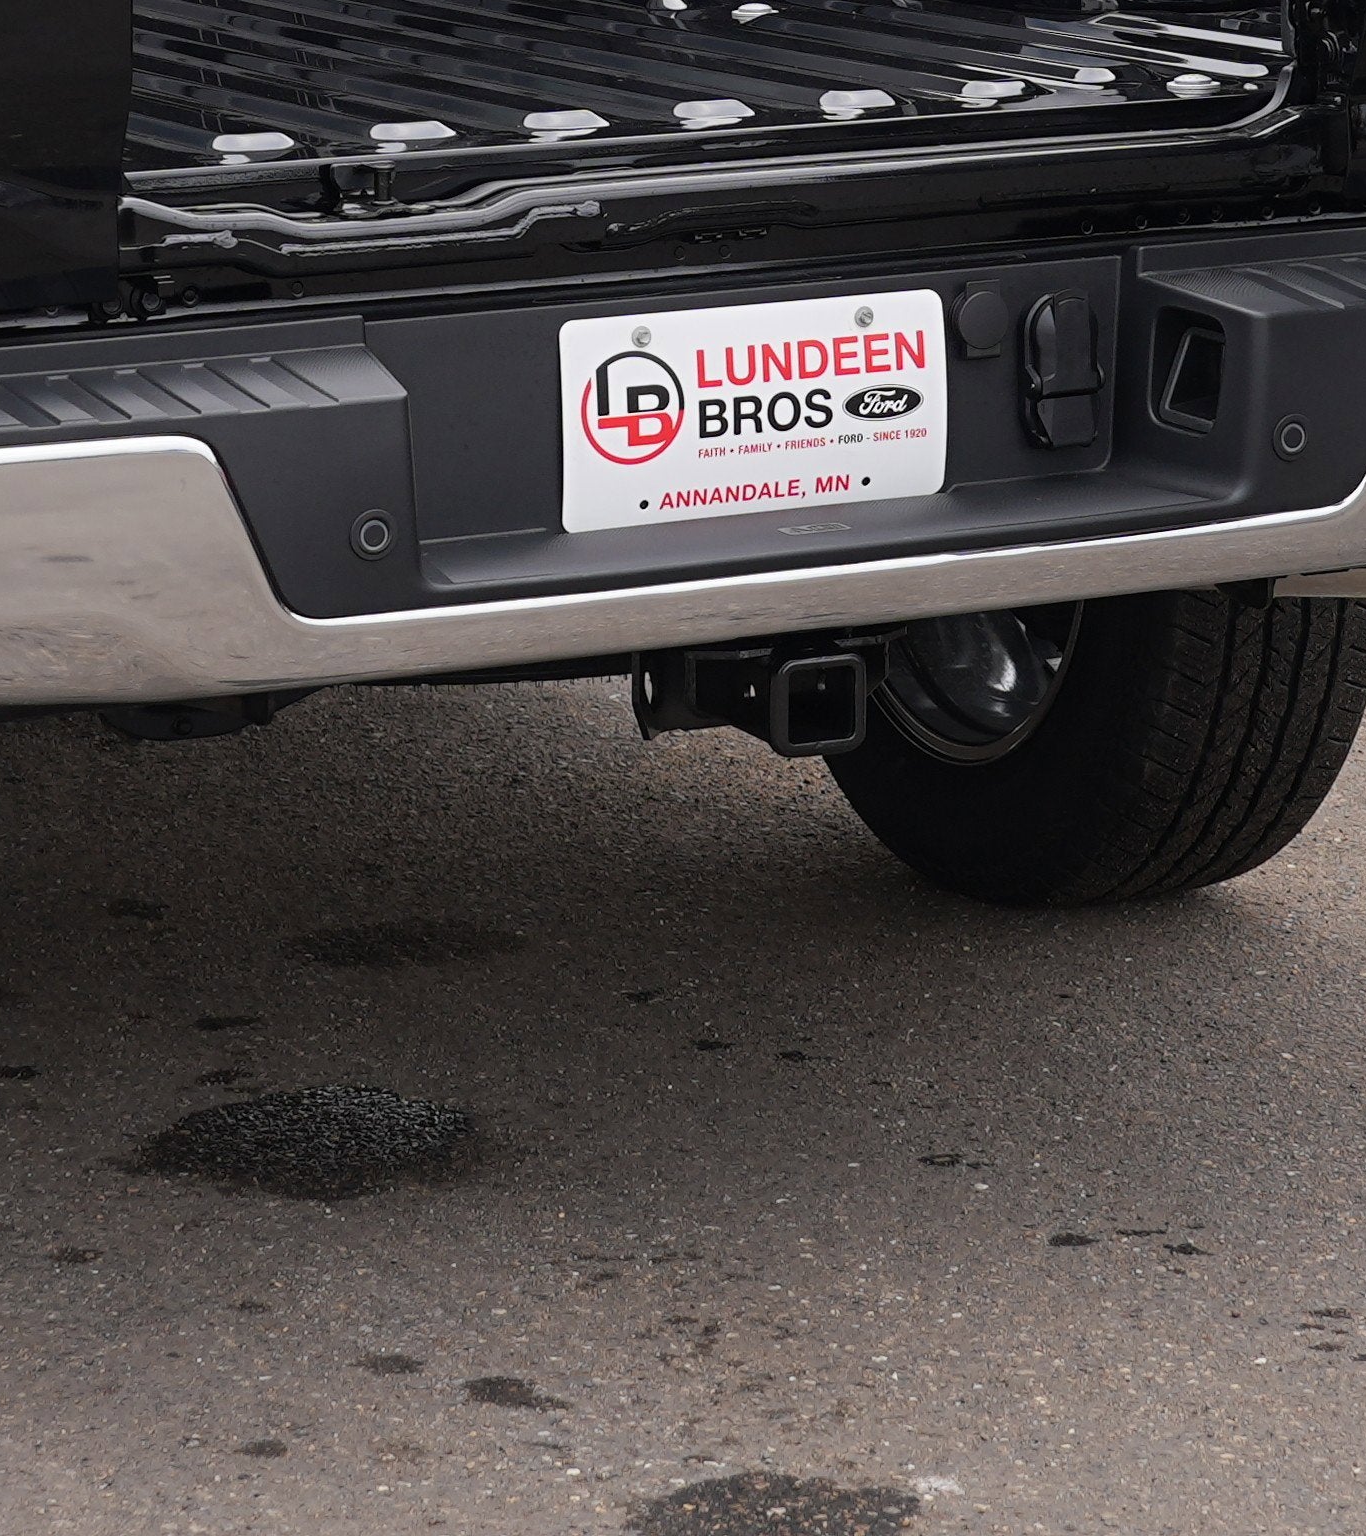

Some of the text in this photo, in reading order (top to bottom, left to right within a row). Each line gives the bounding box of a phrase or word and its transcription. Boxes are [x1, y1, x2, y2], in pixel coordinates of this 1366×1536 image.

[696, 330, 926, 389] LUNDEEN
[698, 388, 833, 439] BROS
[698, 427, 927, 459] FAITH FAMILY FRIENDS FORD SINCE 1920
[659, 474, 850, 511] ANNANDALE, MN
